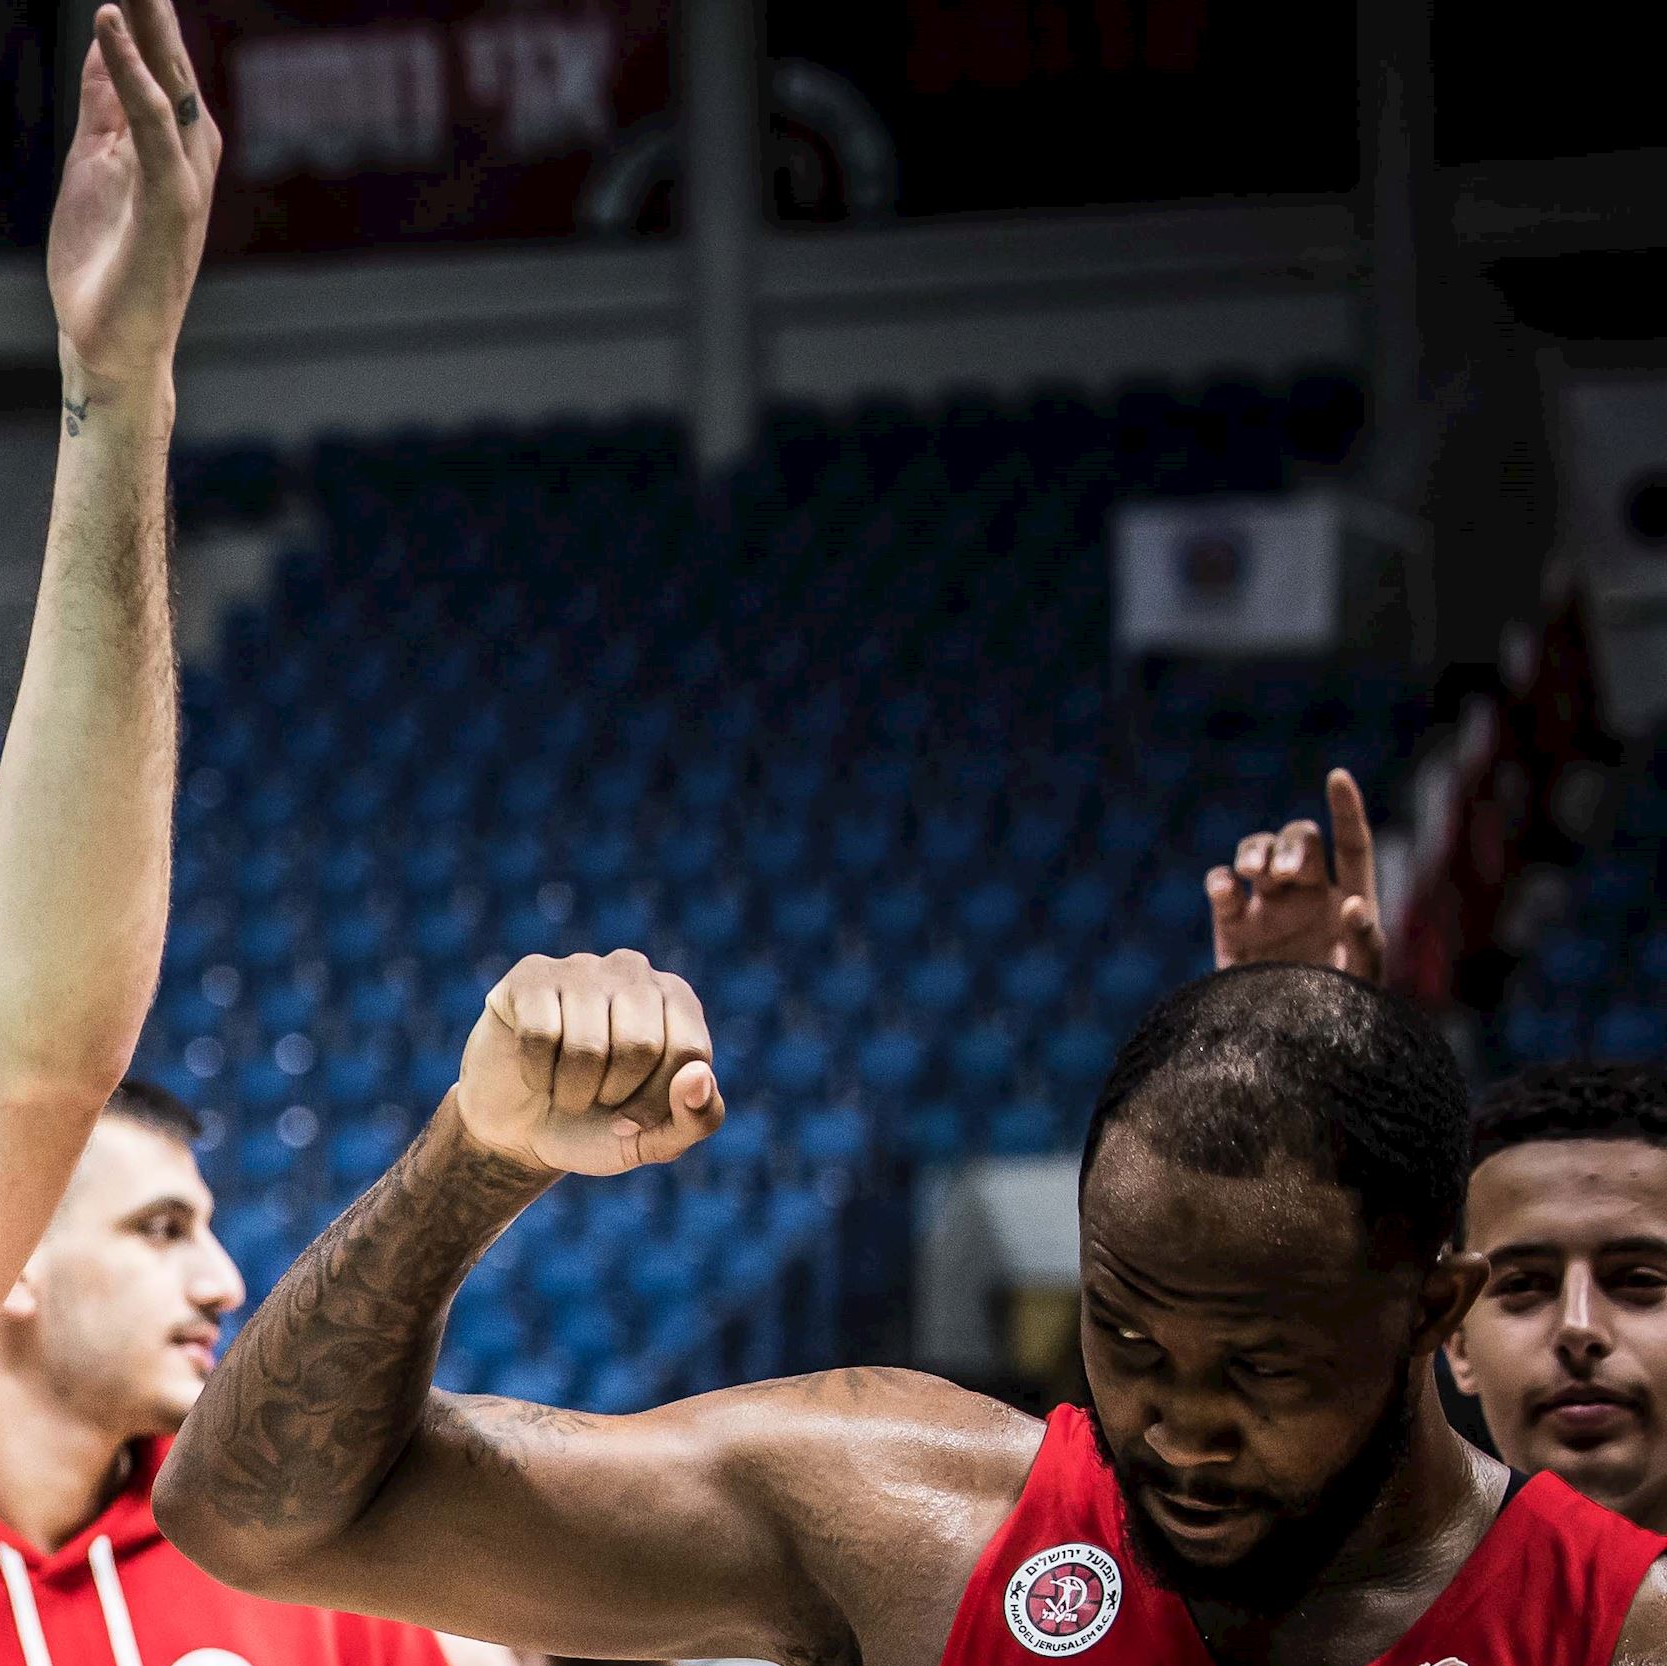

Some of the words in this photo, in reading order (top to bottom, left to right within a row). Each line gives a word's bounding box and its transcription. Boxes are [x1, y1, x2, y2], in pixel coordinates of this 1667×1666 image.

[1025, 1549, 1081, 1577] ירושלים
[1086, 1549, 1116, 1584] הפועל
[1010, 1604, 1037, 1644] HAPOEL
[1033, 1630, 1097, 1652] JERUSALEM
